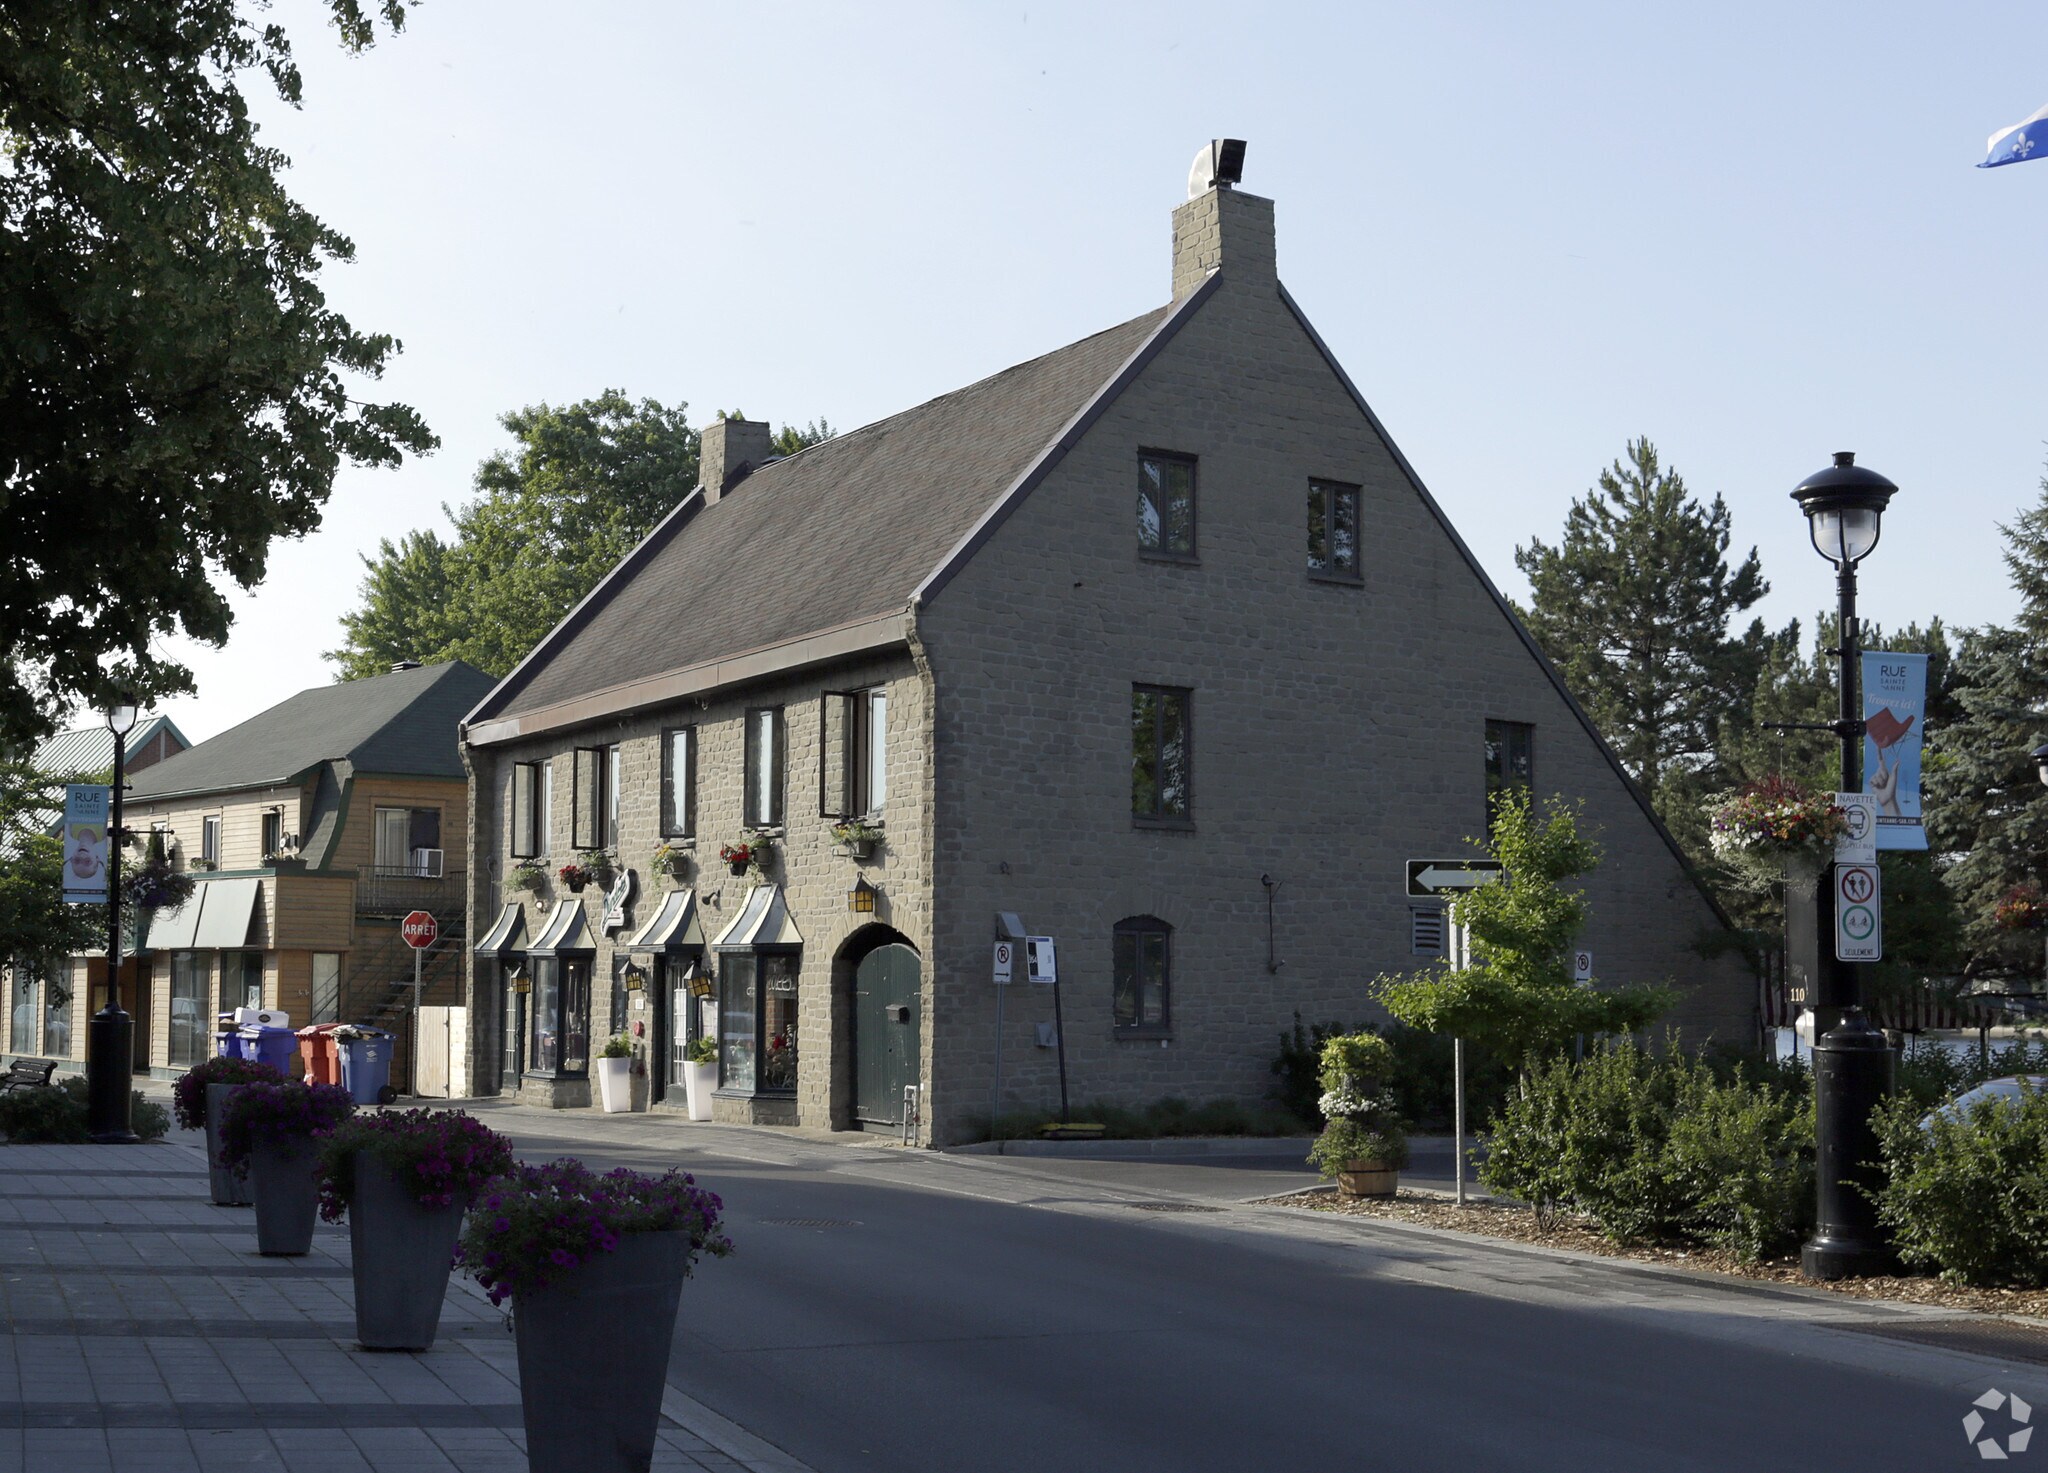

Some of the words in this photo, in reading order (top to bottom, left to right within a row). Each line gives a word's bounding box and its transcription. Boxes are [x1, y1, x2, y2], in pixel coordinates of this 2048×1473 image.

[1880, 665, 1906, 677] RUE
[75, 792, 100, 802] RUE
[1839, 795, 1874, 804] NAVETTE
[404, 923, 435, 935] ARRÊT
[1844, 948, 1873, 956] SEULEMENT
[1790, 987, 1806, 1002] 110
